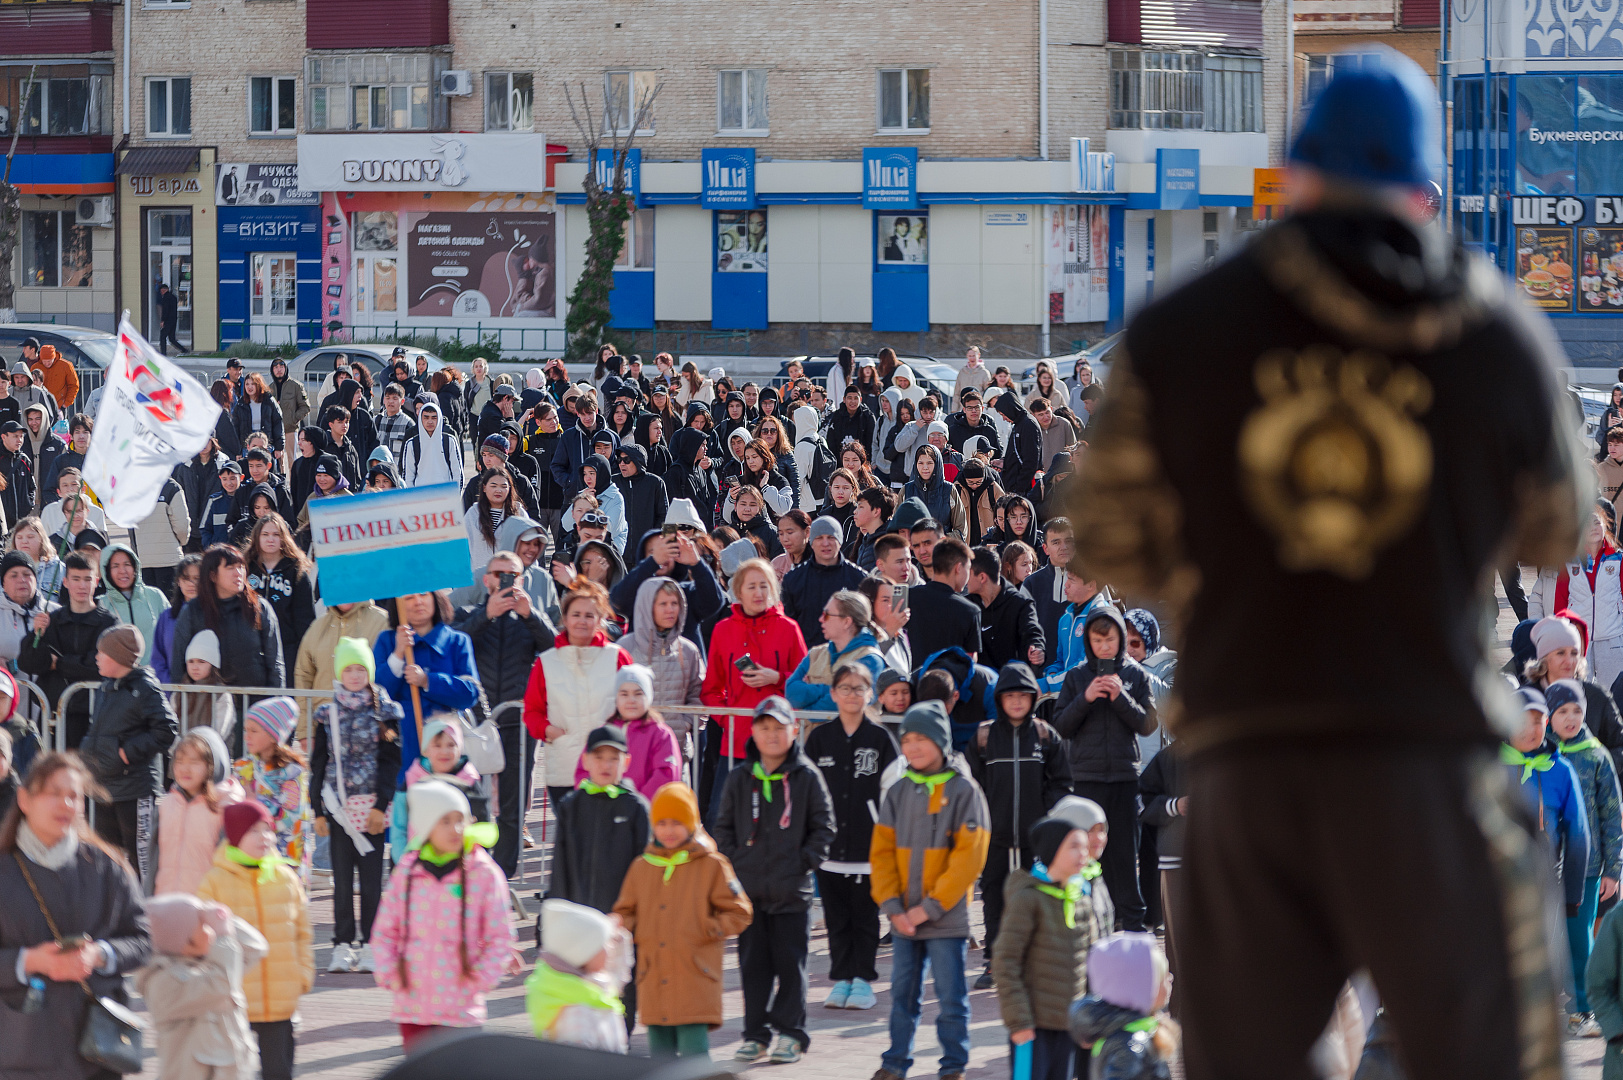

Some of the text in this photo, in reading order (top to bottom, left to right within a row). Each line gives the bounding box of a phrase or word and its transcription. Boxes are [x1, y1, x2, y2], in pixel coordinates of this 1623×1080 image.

[1530, 128, 1623, 144] Букмекерск
[343, 159, 441, 182] BUNNY
[130, 175, 202, 196] Шарм
[1513, 196, 1584, 226] ШЕФ
[239, 221, 301, 236] ВИЗИТ
[417, 224, 452, 233] МАГАЗИН
[417, 235, 485, 246] ДЕТСКОЙ ОДЕЖДЫ
[321, 510, 456, 544] ГИМНАЗИЯ
